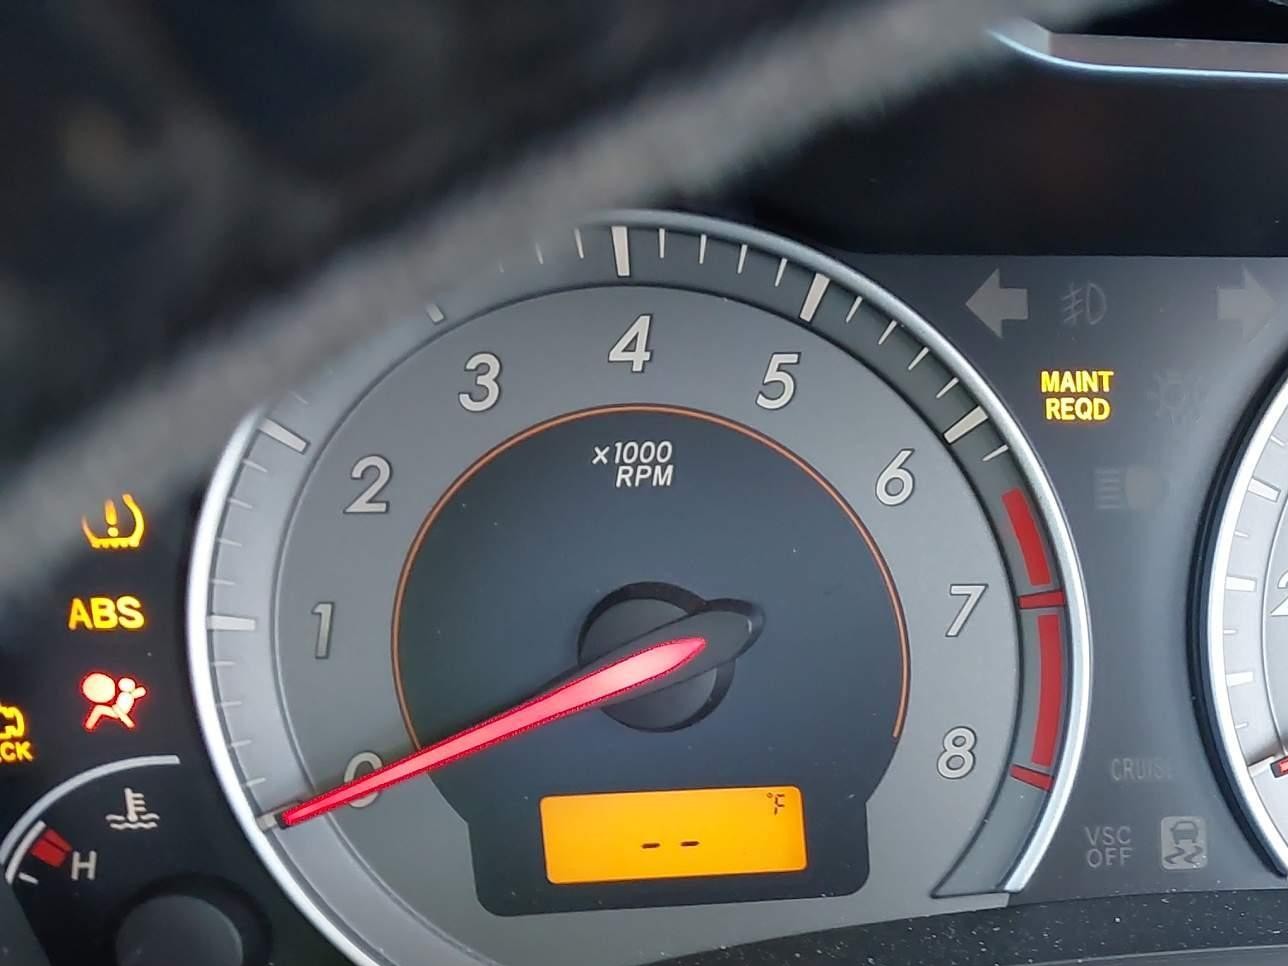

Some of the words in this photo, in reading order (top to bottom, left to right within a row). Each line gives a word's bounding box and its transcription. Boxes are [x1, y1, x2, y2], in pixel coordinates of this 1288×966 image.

[607, 314, 654, 373] 4
[458, 352, 501, 412] 3
[755, 352, 801, 410] 5
[1040, 370, 1114, 393] MAINT
[1045, 397, 1111, 421] REQD
[343, 455, 393, 514] 2
[614, 465, 674, 487] RPM
[874, 448, 916, 506] 6
[67, 595, 145, 630] ABS
[310, 602, 335, 659] 1
[944, 583, 989, 638] 7
[935, 725, 978, 780] 8
[1110, 757, 1176, 783] CRUIS
[1084, 825, 1132, 846] VSC
[1086, 847, 1136, 868] OFF
[71, 850, 97, 881] H
